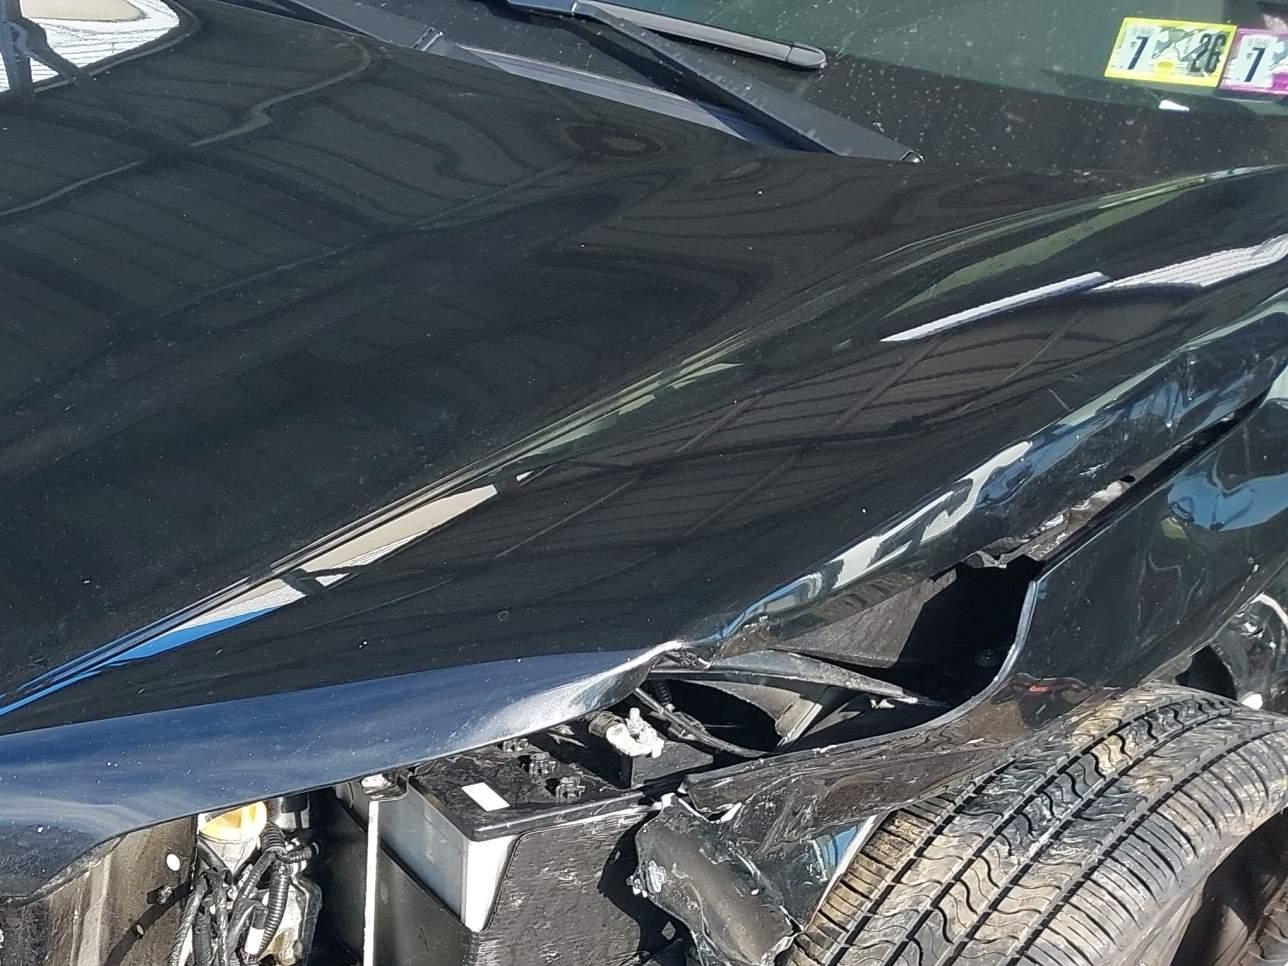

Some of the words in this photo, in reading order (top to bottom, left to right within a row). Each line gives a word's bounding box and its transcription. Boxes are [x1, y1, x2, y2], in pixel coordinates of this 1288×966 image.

[1128, 36, 1150, 70] 7
[1189, 32, 1227, 74] 26
[1244, 46, 1266, 83] 7
